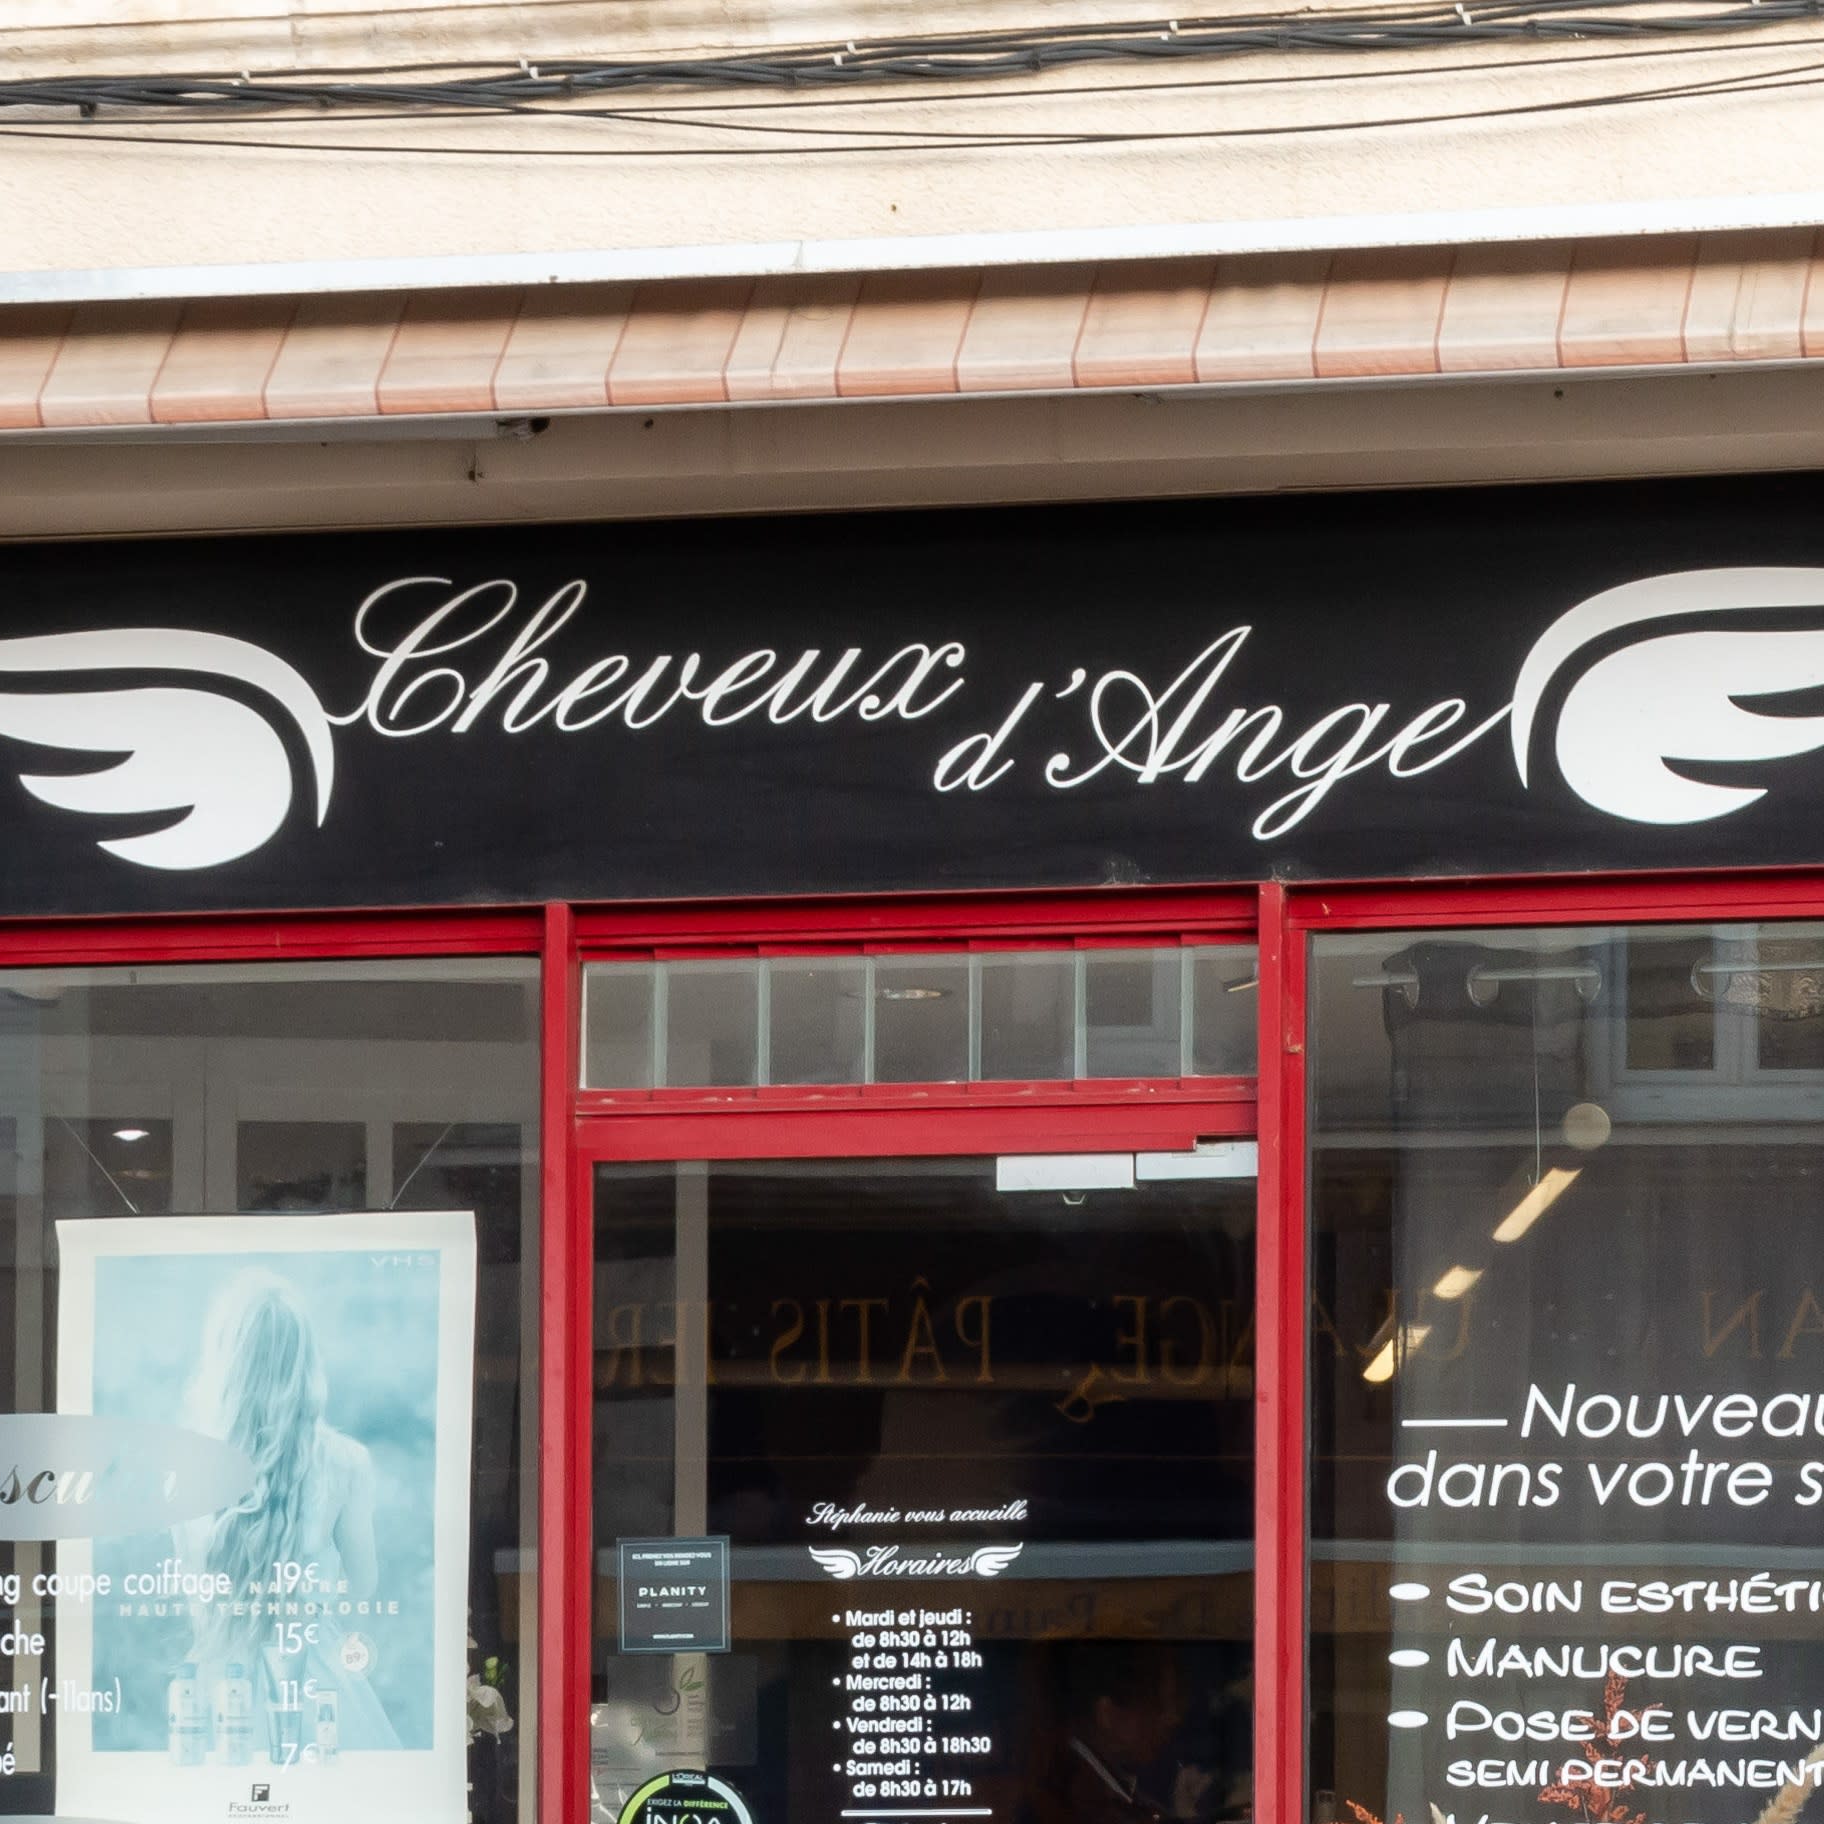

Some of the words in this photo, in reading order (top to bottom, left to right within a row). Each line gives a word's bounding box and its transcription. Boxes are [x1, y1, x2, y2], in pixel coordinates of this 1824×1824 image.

[326, 575, 966, 737] Cheveux
[933, 625, 1513, 841] d'Ange
[1386, 1449, 1564, 1508] dans
[1587, 1448, 1774, 1507] votre
[805, 1502, 901, 1531] Stéphanie
[904, 1509, 946, 1522] vous
[949, 1499, 1028, 1521] accueille
[857, 1544, 972, 1576] Horaires
[32, 1572, 111, 1604] coupe
[124, 1559, 231, 1605] coiffage
[273, 1560, 320, 1596] 19€
[638, 1586, 707, 1597] PLANITY
[1446, 1573, 1582, 1614] SOIN
[218, 1601, 401, 1616] TECHNOLOGIE
[846, 1609, 895, 1627] Mardi
[897, 1610, 916, 1626] et
[918, 1608, 963, 1629] jeudi
[275, 1622, 319, 1654] 15€
[851, 1631, 876, 1648] de
[879, 1630, 920, 1647] 8h30
[923, 1629, 937, 1647] à
[941, 1630, 971, 1646] 12h
[851, 1652, 870, 1669] et
[873, 1652, 897, 1669] de
[902, 1651, 932, 1668] 14h
[935, 1649, 948, 1668] à
[952, 1651, 982, 1668] 18h
[1446, 1637, 1764, 1679] MANUCURE
[280, 1679, 318, 1711] 11€
[846, 1674, 922, 1691] Mercredi
[852, 1695, 876, 1712] de
[879, 1694, 920, 1711] 8h30
[923, 1693, 937, 1711] à
[941, 1694, 972, 1711] 12h
[846, 1716, 923, 1734] Vendredi
[1446, 1700, 1594, 1742] POSE
[1608, 1708, 1675, 1741] DE
[852, 1738, 877, 1755] de
[879, 1737, 920, 1754] 8h30
[923, 1736, 937, 1754] à
[941, 1736, 991, 1754] 18h30
[280, 1743, 318, 1774] 7€
[846, 1759, 911, 1776] Samedi
[1446, 1758, 1550, 1788] SEMI
[852, 1781, 877, 1798] de
[879, 1780, 921, 1797] 8h30
[923, 1778, 937, 1797] à
[941, 1779, 972, 1796] 17h
[647, 1798, 672, 1807] EXIGEZ
